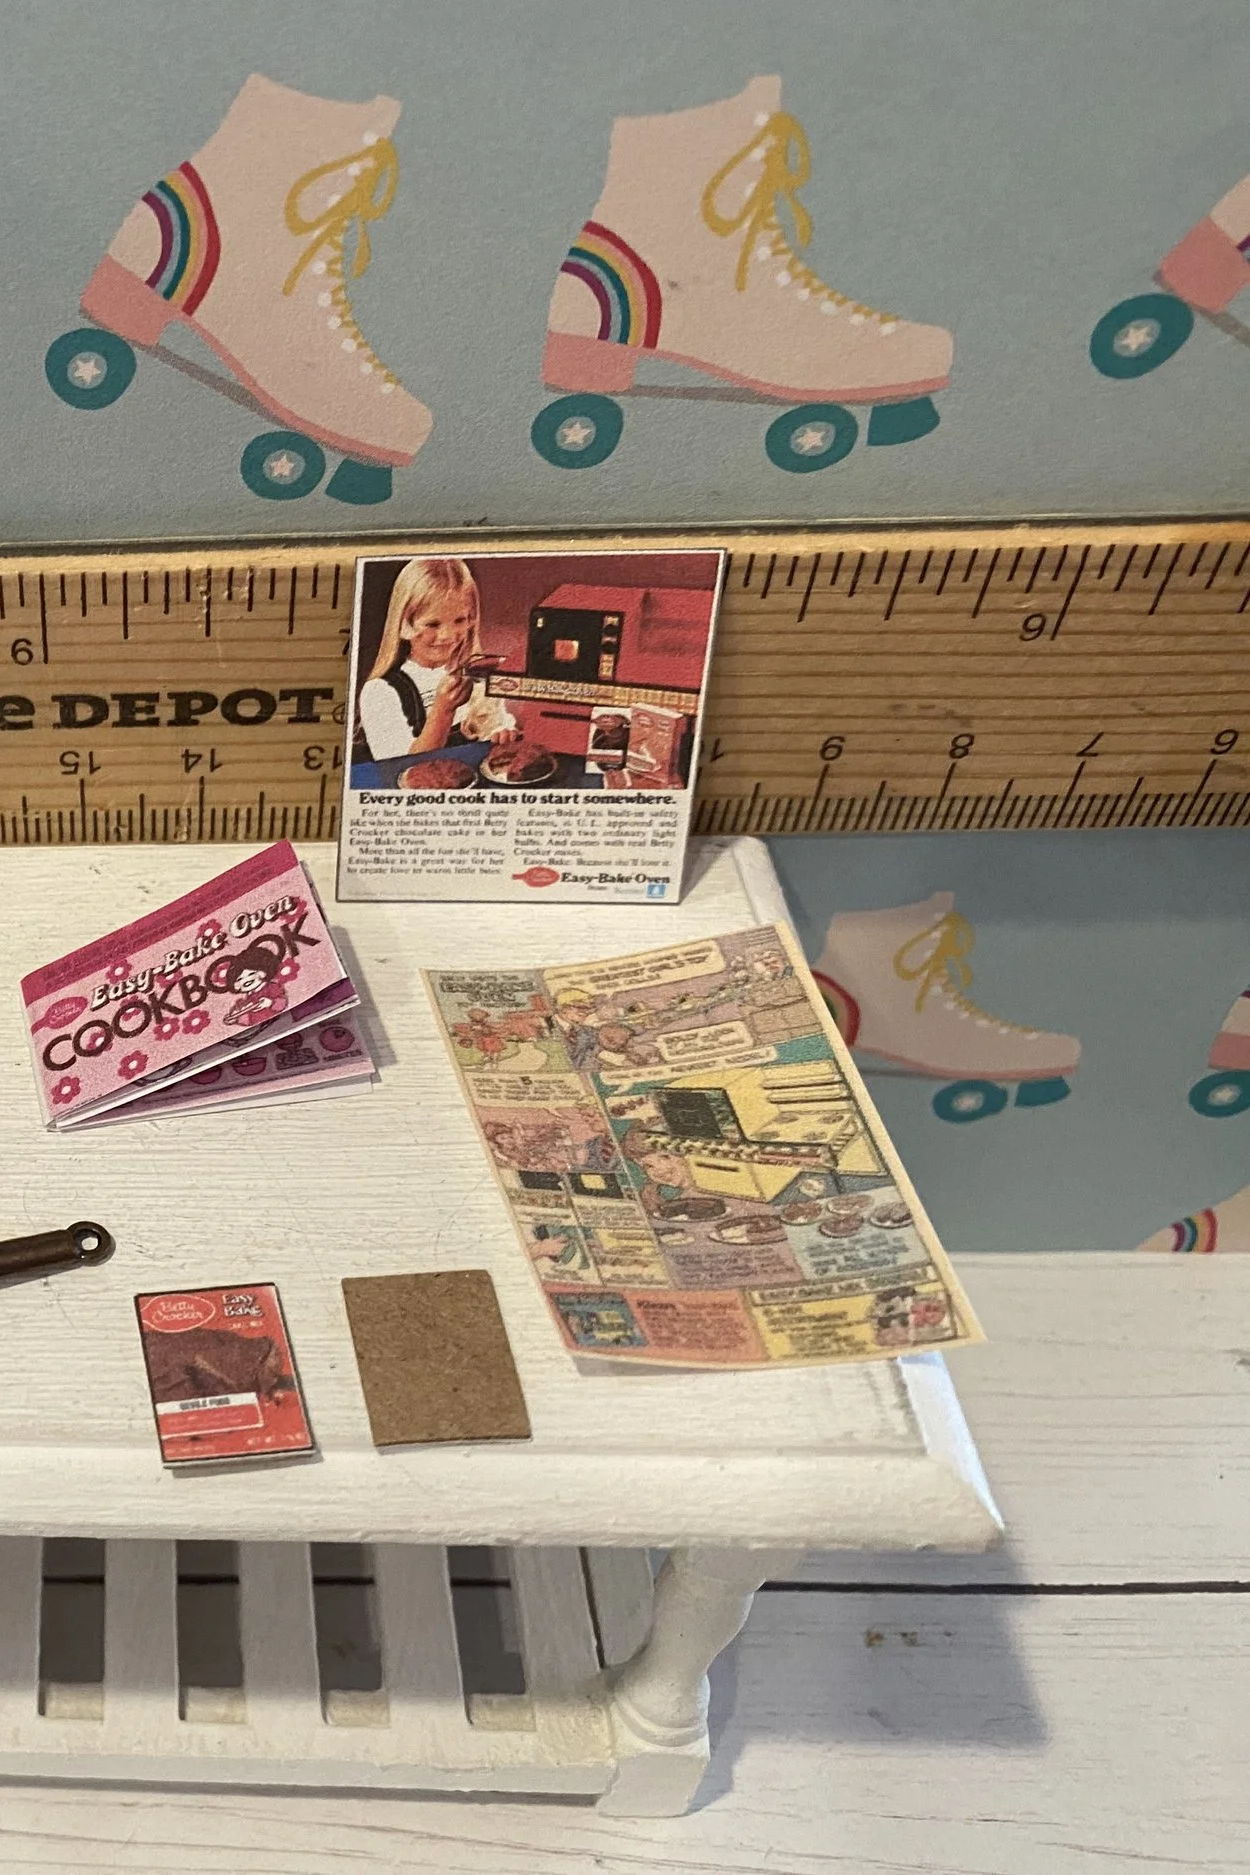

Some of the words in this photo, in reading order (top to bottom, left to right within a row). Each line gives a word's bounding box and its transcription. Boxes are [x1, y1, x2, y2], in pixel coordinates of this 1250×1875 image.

[1019, 613, 1047, 642] 9
[11, 637, 34, 666] 6
[51, 688, 334, 728] DEPOT
[303, 745, 343, 770] 13
[950, 734, 975, 760] 8
[1076, 732, 1105, 758] 7
[60, 750, 103, 775] 15
[181, 748, 224, 774] 14
[359, 792, 405, 806] Every
[407, 792, 445, 806] good
[449, 792, 486, 804] cook
[490, 792, 517, 804] has
[521, 793, 536, 804] to
[540, 793, 579, 804] start
[583, 792, 677, 804] somewhere.
[350, 829, 389, 837] Crocker
[395, 829, 442, 837] chocolate
[546, 839, 567, 848] And
[561, 873, 632, 885] Easy-Bake
[636, 873, 670, 883] Oven
[89, 931, 229, 1013] Easy-Bake
[229, 895, 296, 940] Oven
[42, 911, 322, 1072] COOKBOOK
[159, 1301, 195, 1312] Betty
[222, 1294, 256, 1307] Easy
[224, 1304, 263, 1318] Bake
[152, 1309, 204, 1323] Crocker
